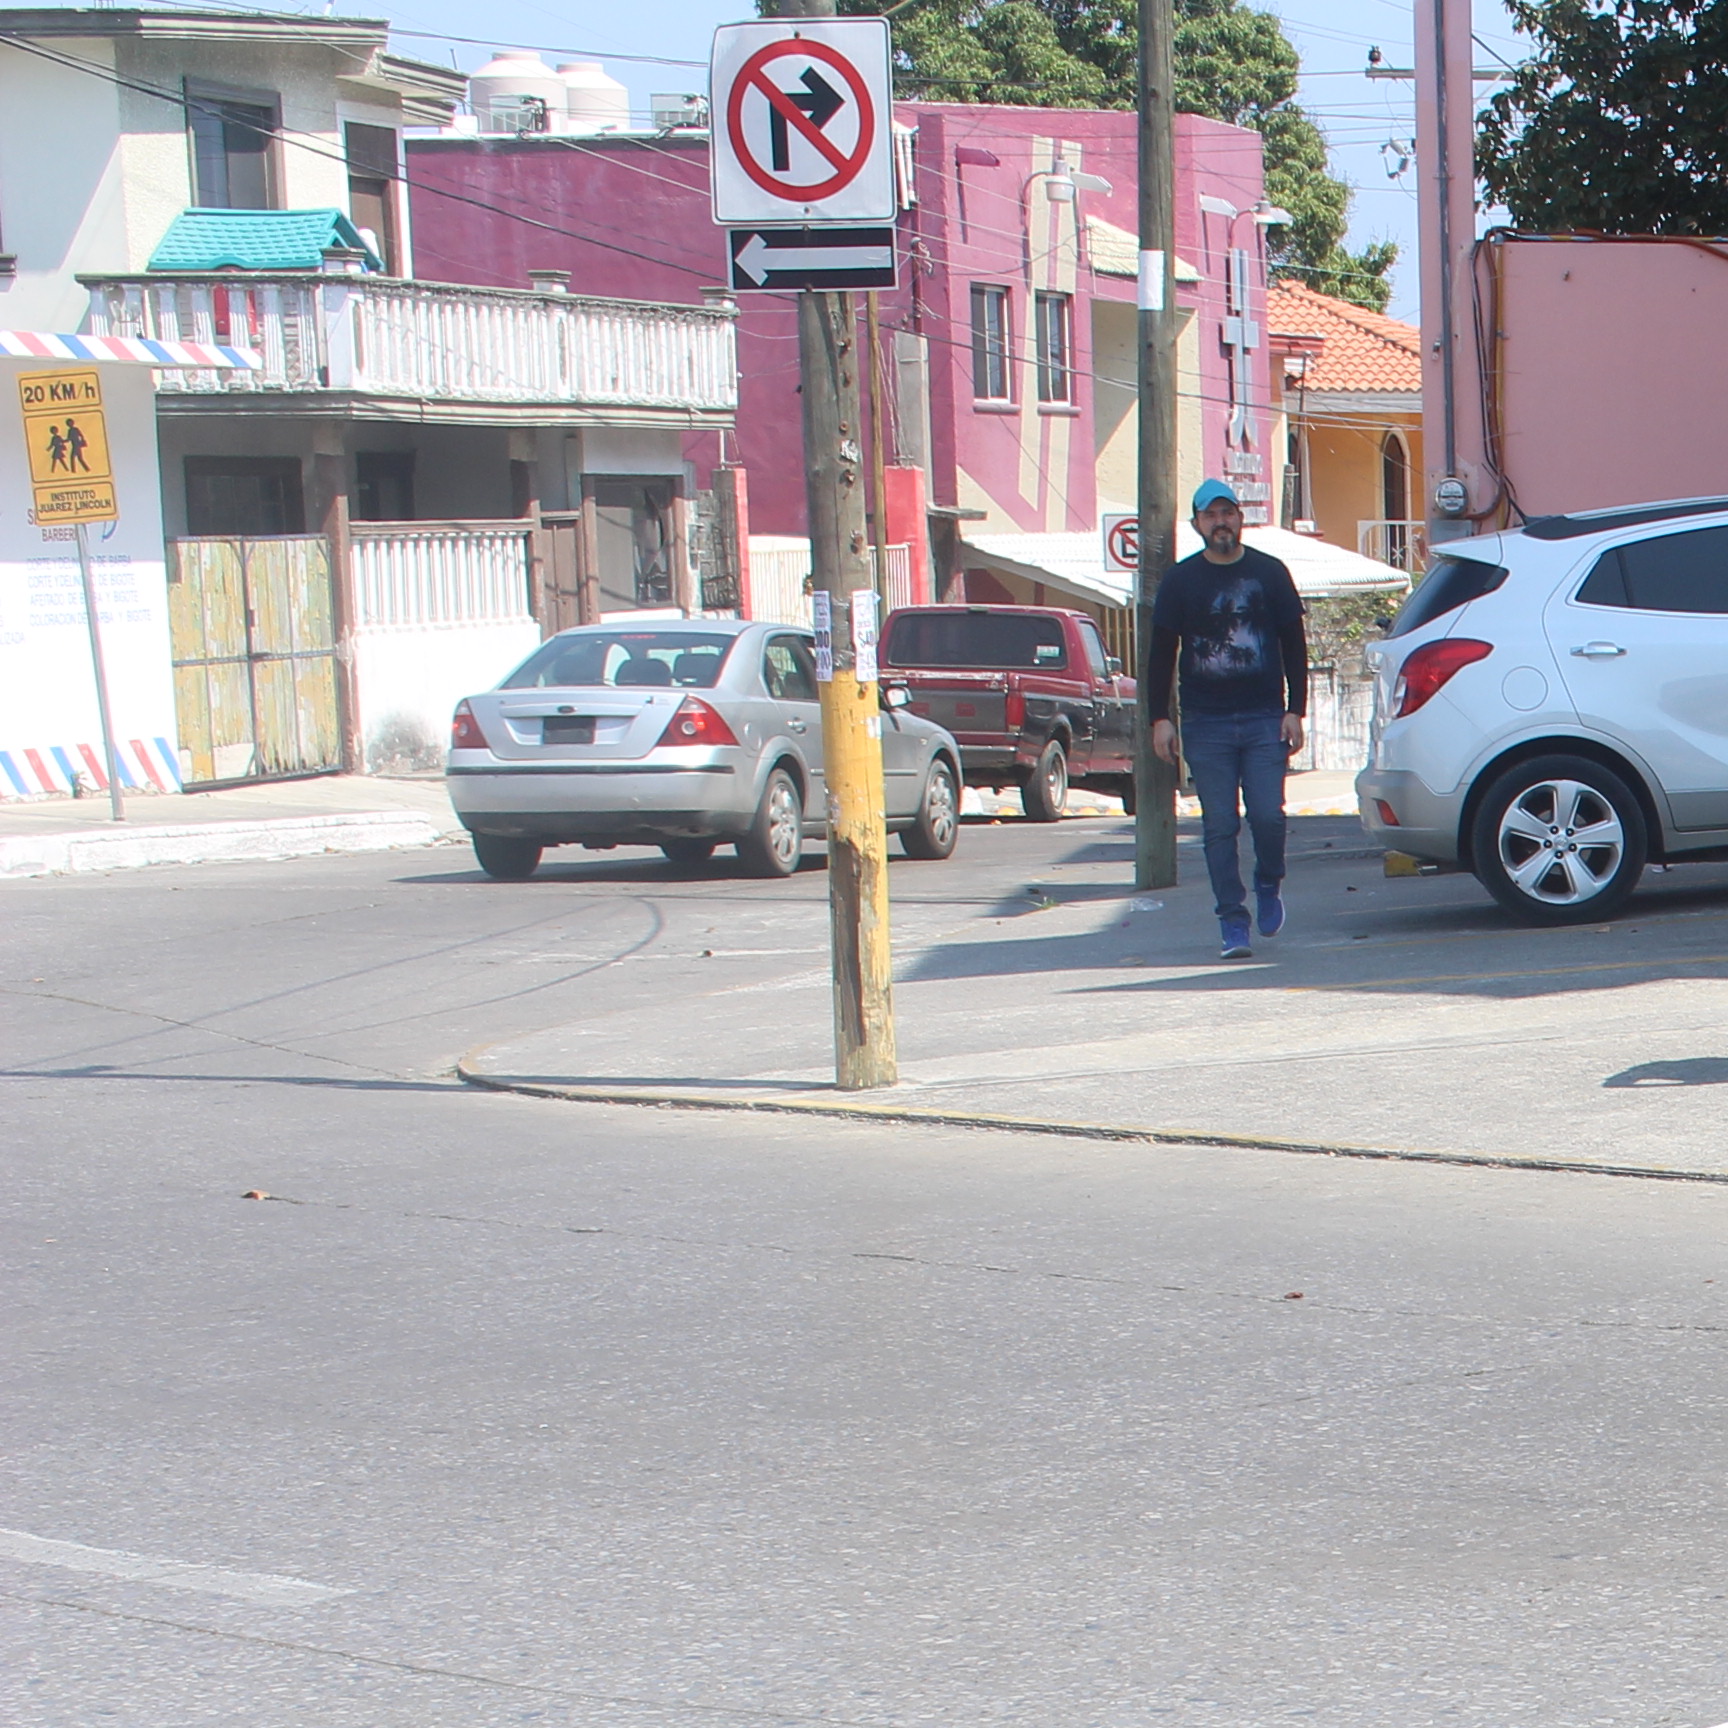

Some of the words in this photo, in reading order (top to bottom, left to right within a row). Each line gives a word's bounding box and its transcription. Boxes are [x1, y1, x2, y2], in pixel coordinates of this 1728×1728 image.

[24, 386, 45, 404] 20
[50, 381, 96, 402] KM/h
[51, 489, 96, 502] INSTITUTO
[38, 501, 73, 513] JUAREZ
[74, 499, 111, 513] LINCOLN
[41, 527, 77, 542] BARBERI
